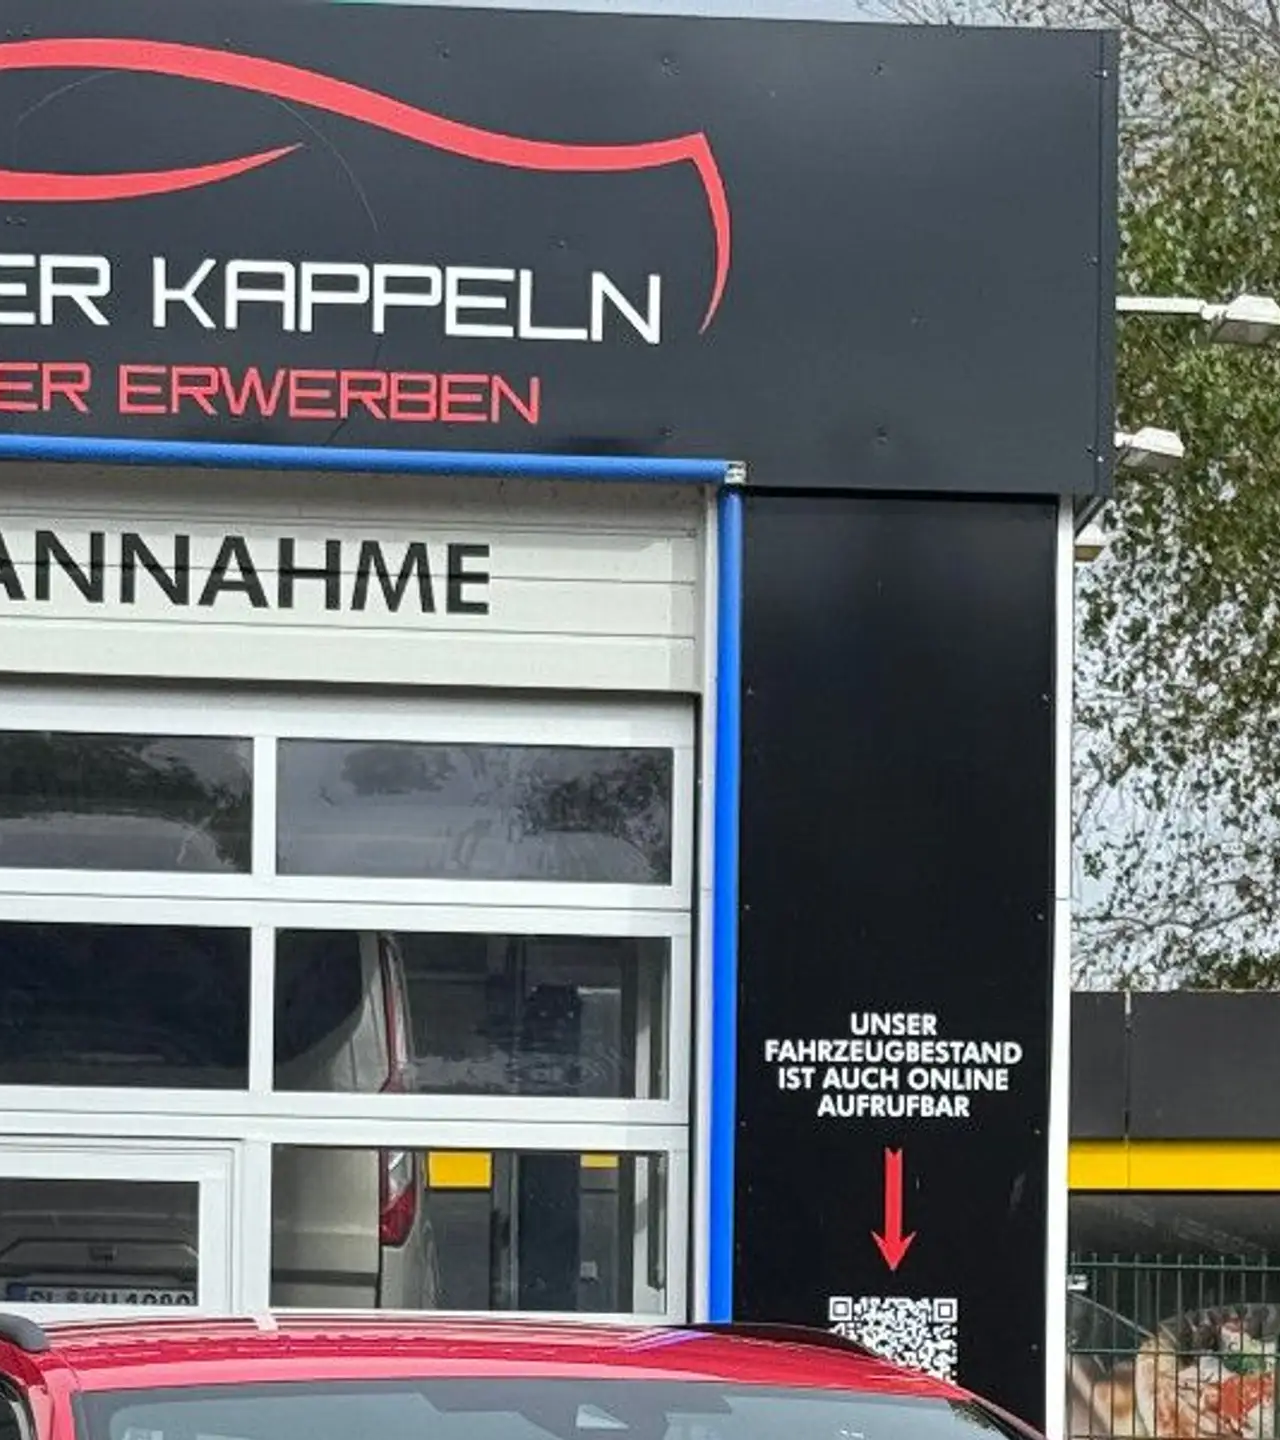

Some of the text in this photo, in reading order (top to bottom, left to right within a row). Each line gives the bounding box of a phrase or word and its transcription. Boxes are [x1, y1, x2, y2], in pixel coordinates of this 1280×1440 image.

[152, 256, 661, 345] KAPPELN
[118, 364, 541, 425] ERWERBEN
[850, 1012, 938, 1036] UNSER
[765, 1039, 1023, 1065] FAHRZEUGBESTAND
[778, 1066, 1009, 1091] IST AUCH ONLINE
[817, 1094, 970, 1118] AUFRUFBAR
